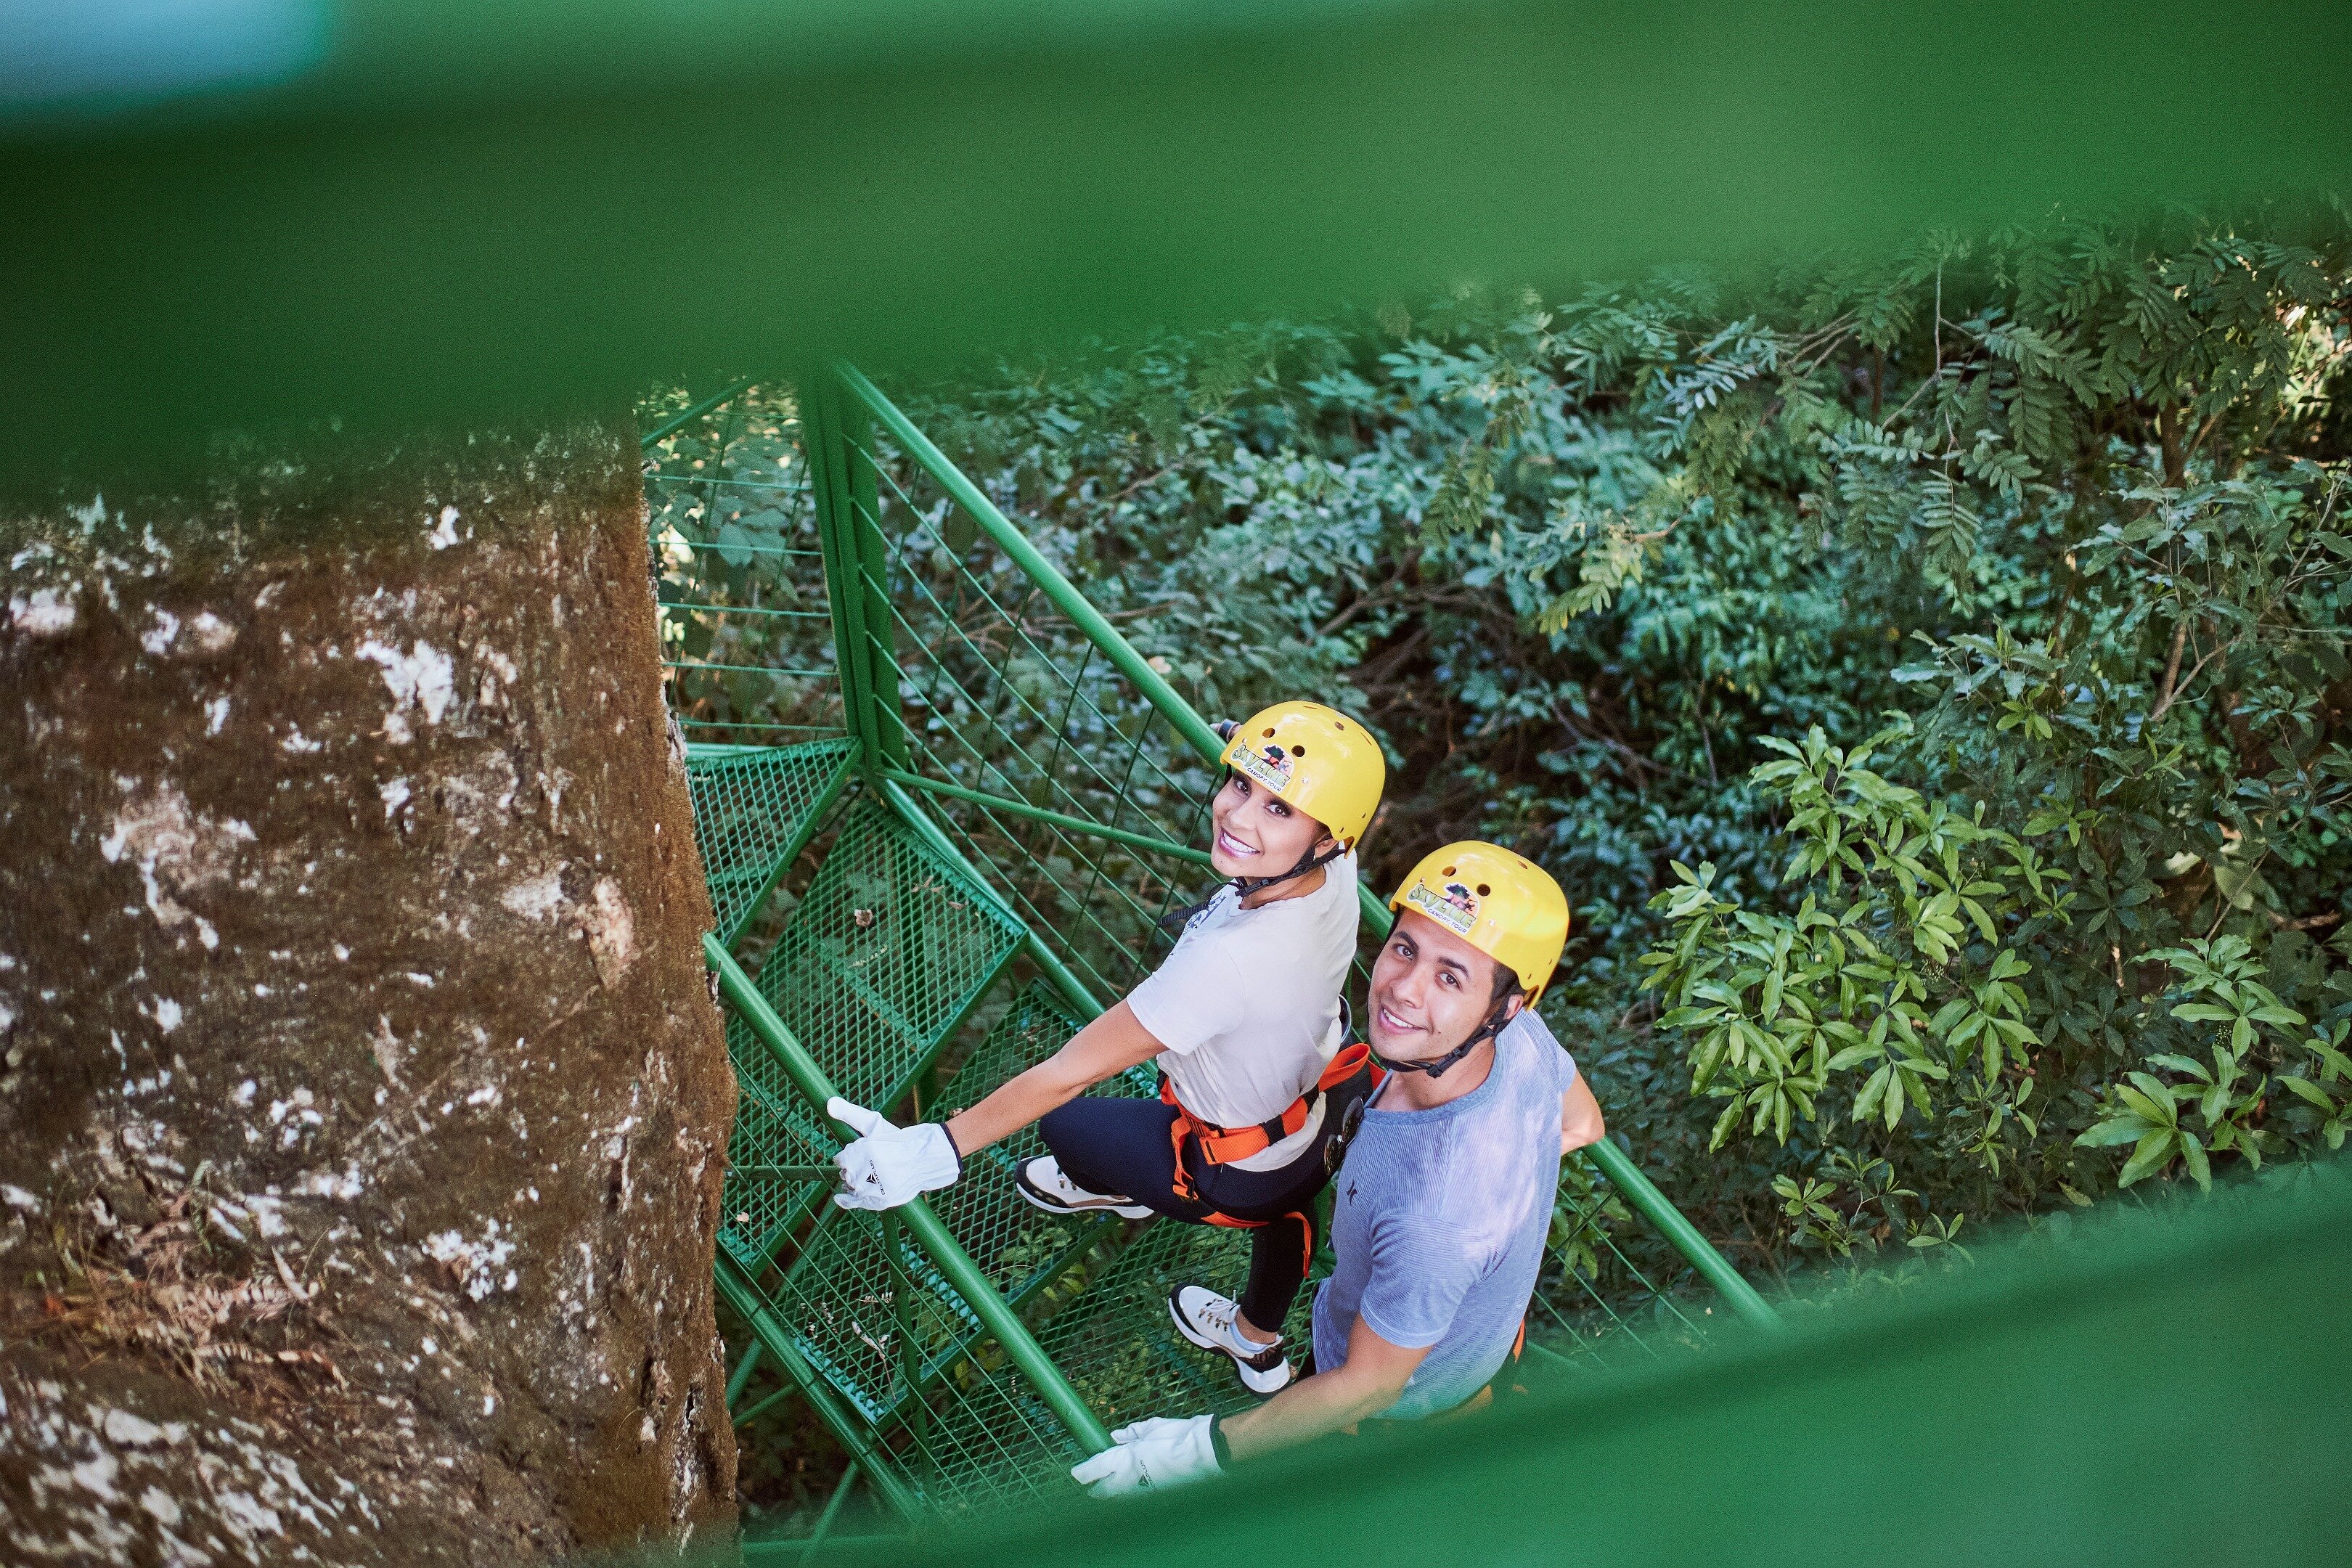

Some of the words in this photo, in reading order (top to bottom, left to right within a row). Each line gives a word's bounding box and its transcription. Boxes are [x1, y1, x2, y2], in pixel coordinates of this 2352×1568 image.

[1232, 744, 1291, 788] SKYLINE
[1246, 767, 1267, 782] CANOPY
[1267, 780, 1282, 792] TOUR
[1408, 883, 1477, 928] SKYLINE
[1427, 908, 1451, 923] CANOPY
[1452, 921, 1467, 934] TOUR
